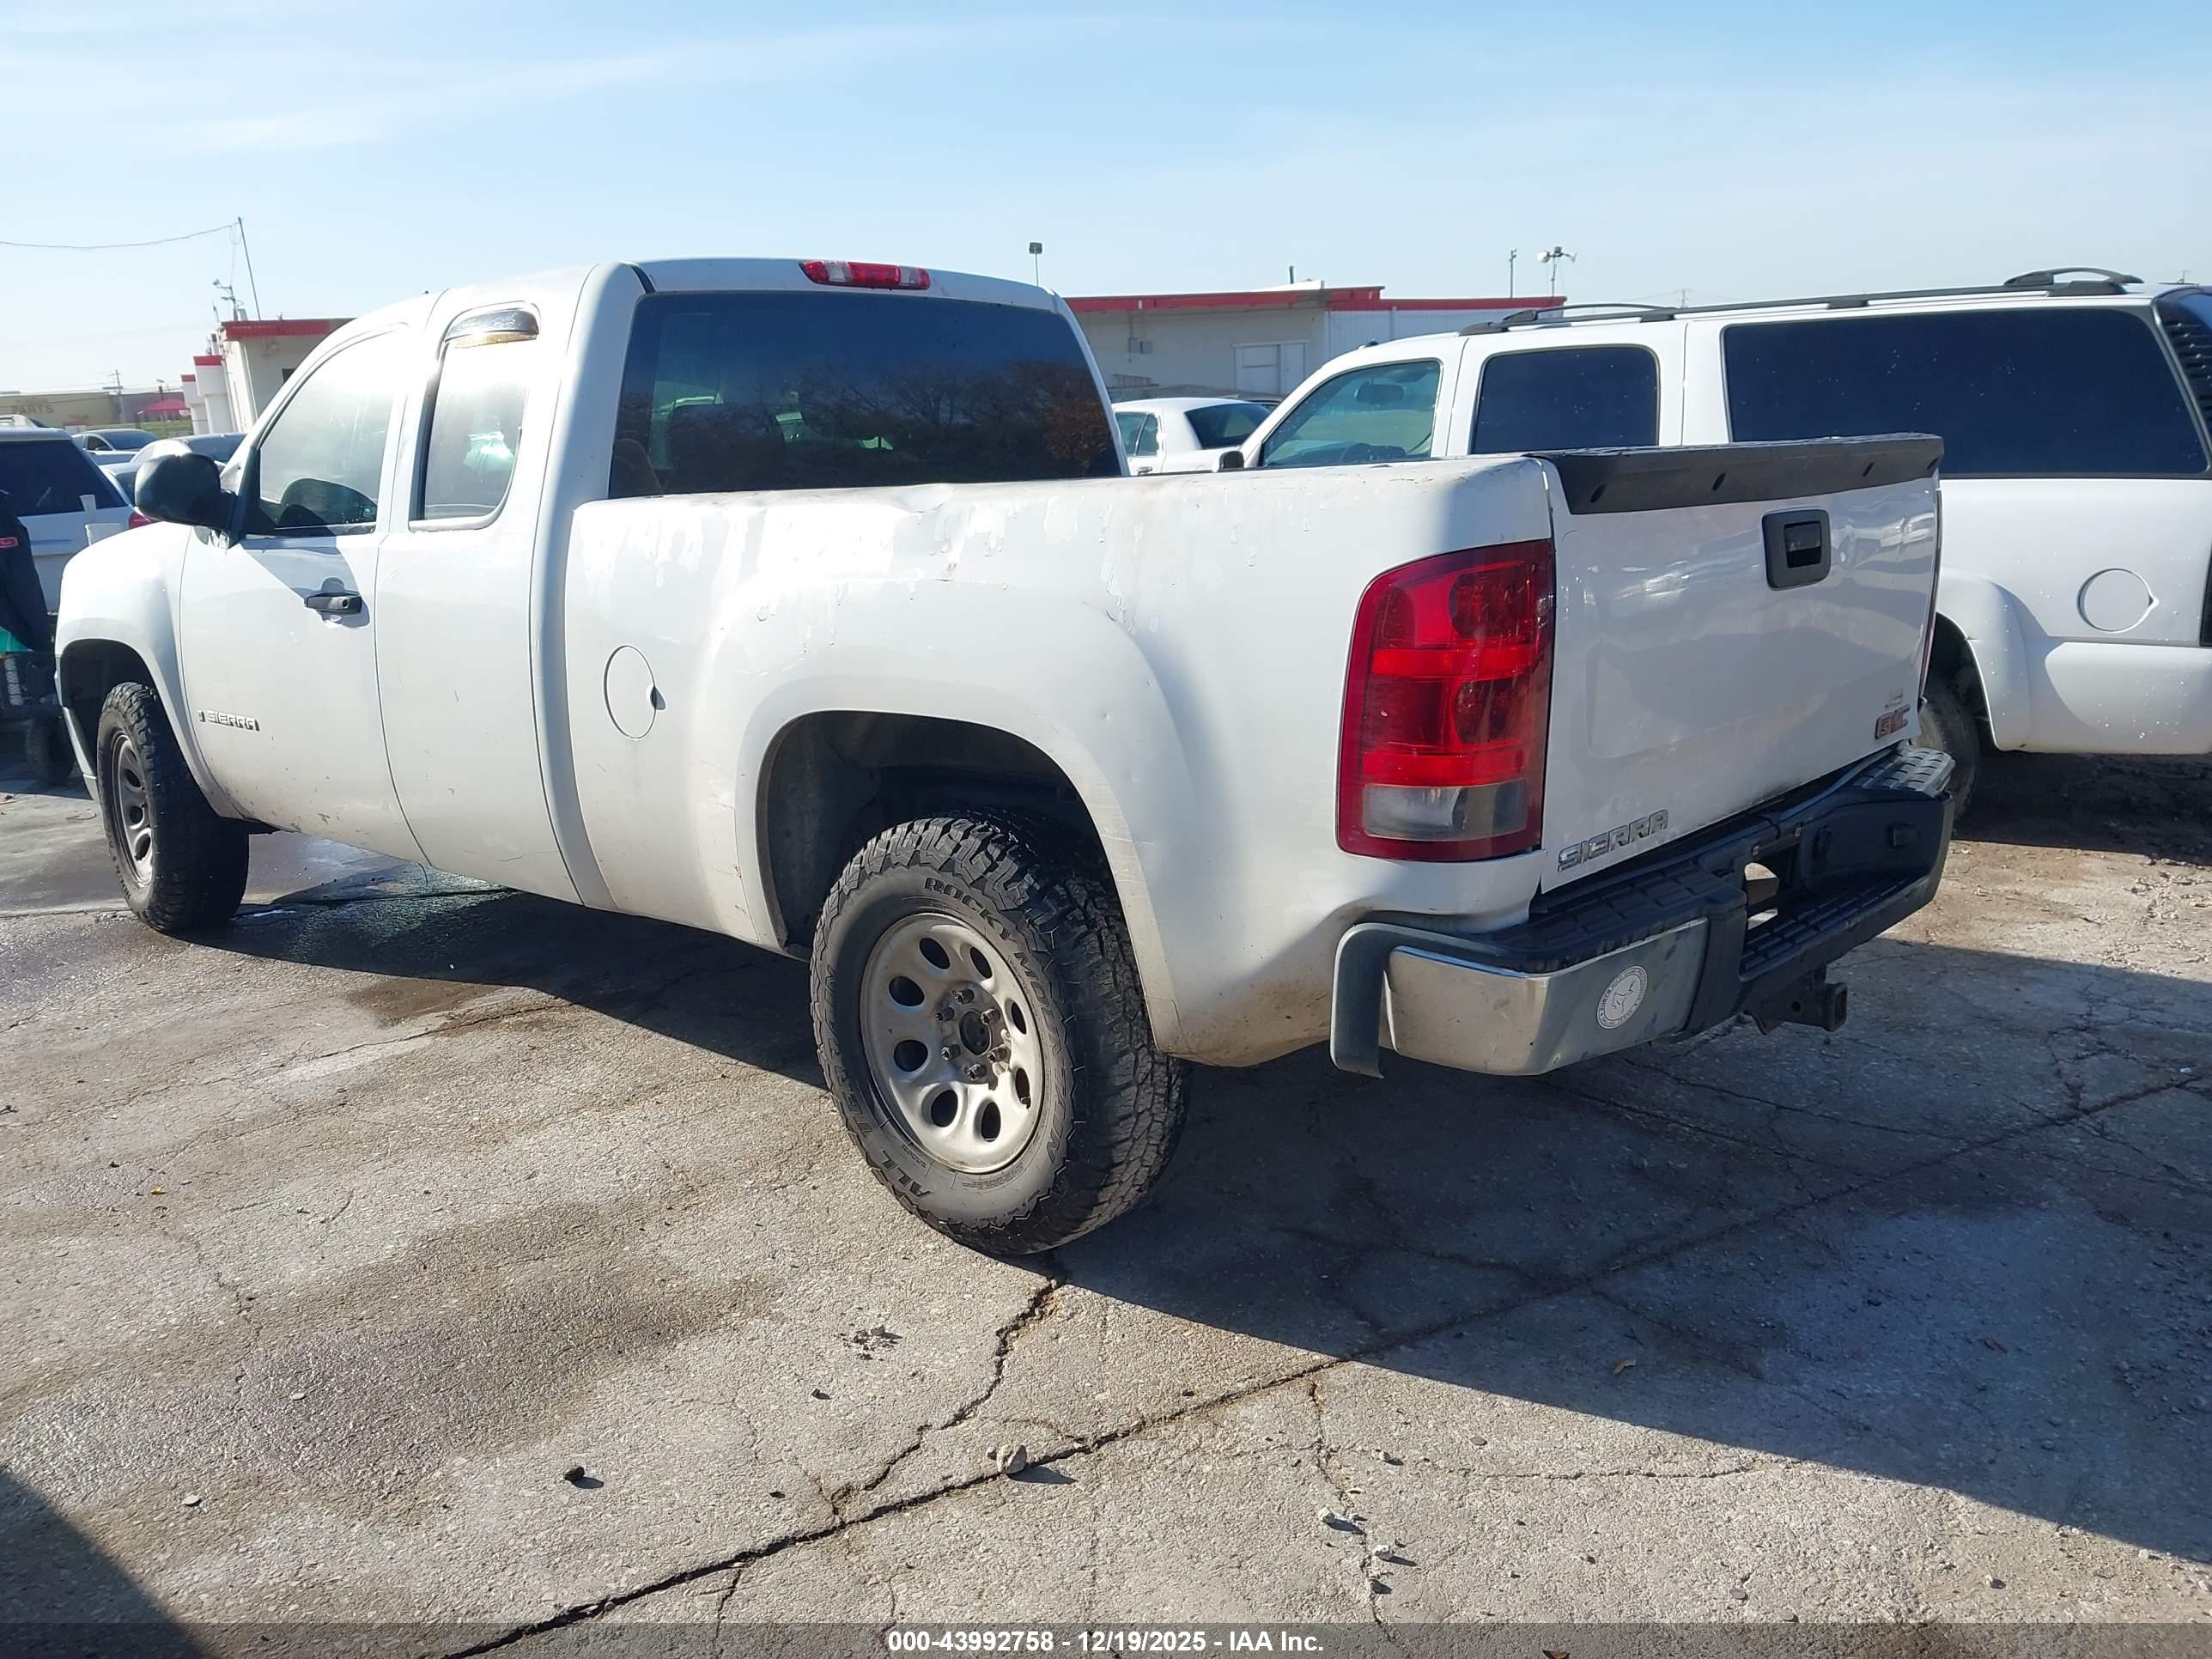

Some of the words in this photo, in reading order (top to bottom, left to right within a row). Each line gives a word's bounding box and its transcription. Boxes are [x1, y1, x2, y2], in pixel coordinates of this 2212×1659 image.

[1558, 809, 1669, 872] SIERRA
[925, 877, 1011, 940] ROCKY
[882, 1150, 933, 1197] ALL
